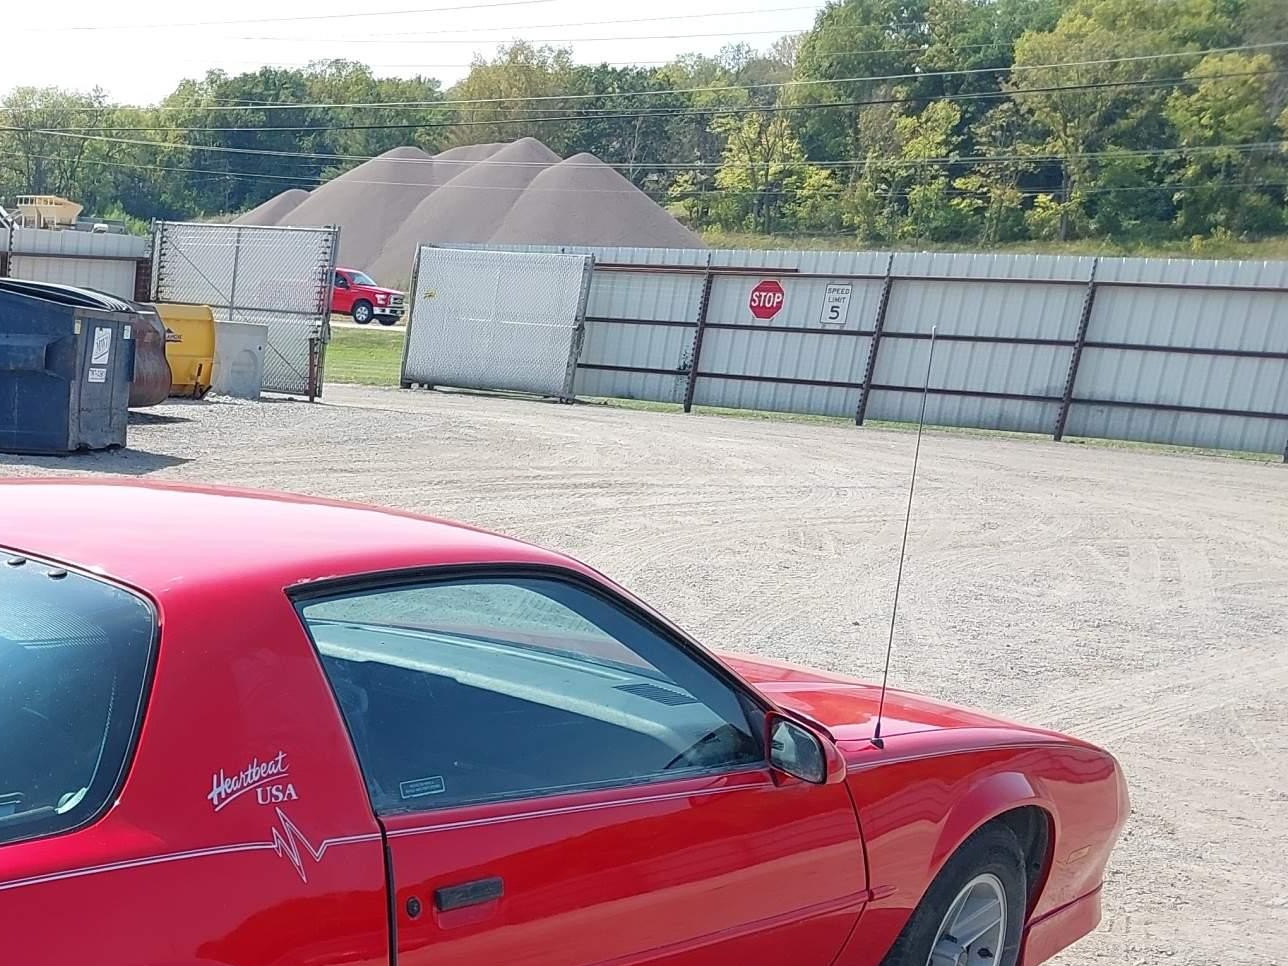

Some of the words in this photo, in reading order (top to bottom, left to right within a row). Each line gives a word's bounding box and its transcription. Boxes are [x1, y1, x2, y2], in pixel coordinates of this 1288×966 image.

[827, 287, 850, 295] SPEED
[751, 291, 783, 308] STOP
[828, 296, 846, 304] LIMIT
[828, 305, 840, 320] 5
[208, 751, 289, 805] Heartbeat
[256, 784, 298, 805] USA
